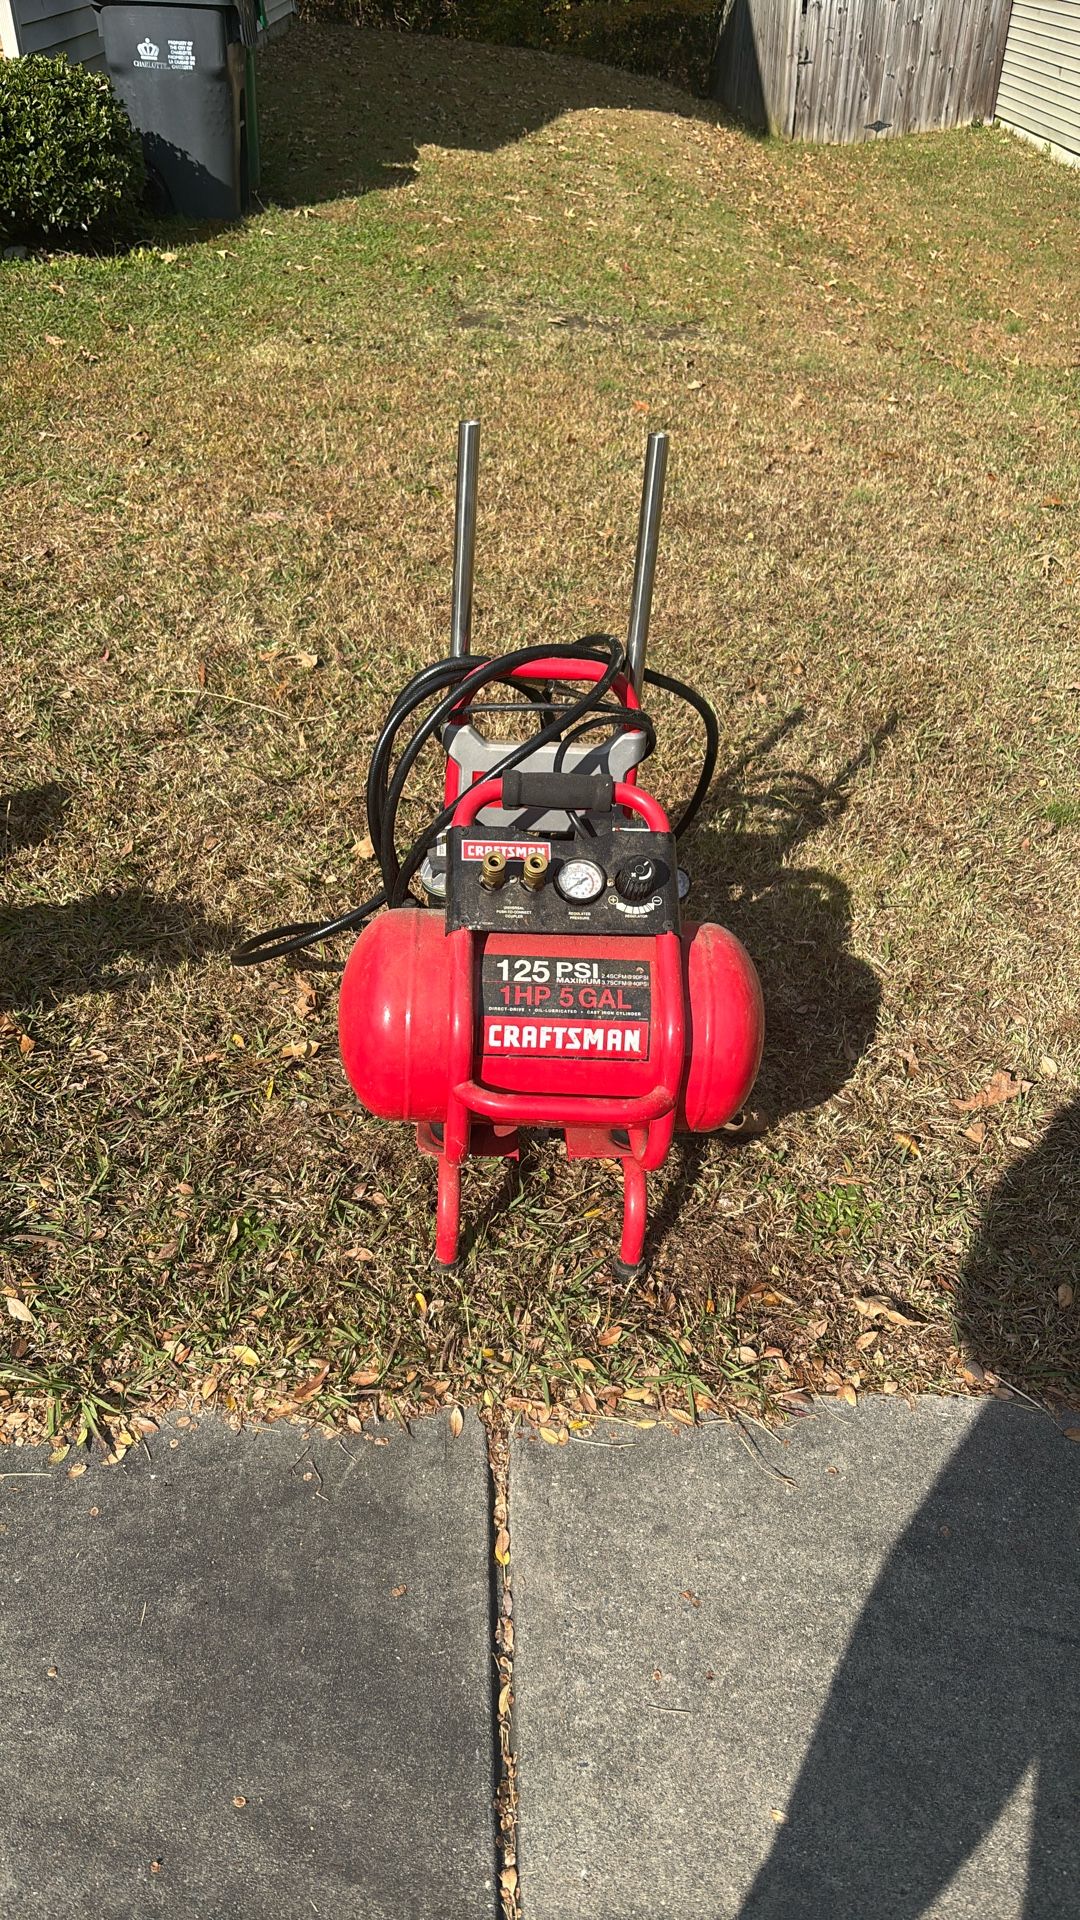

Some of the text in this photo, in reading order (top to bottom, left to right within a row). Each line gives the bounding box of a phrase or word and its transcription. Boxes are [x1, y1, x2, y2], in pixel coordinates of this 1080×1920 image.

[133, 60, 168, 69] CHARLOTTE
[496, 959, 599, 983] 125 PSI
[556, 977, 600, 985] MAXIMUM
[488, 1024, 641, 1053] CRAFTSMAN
